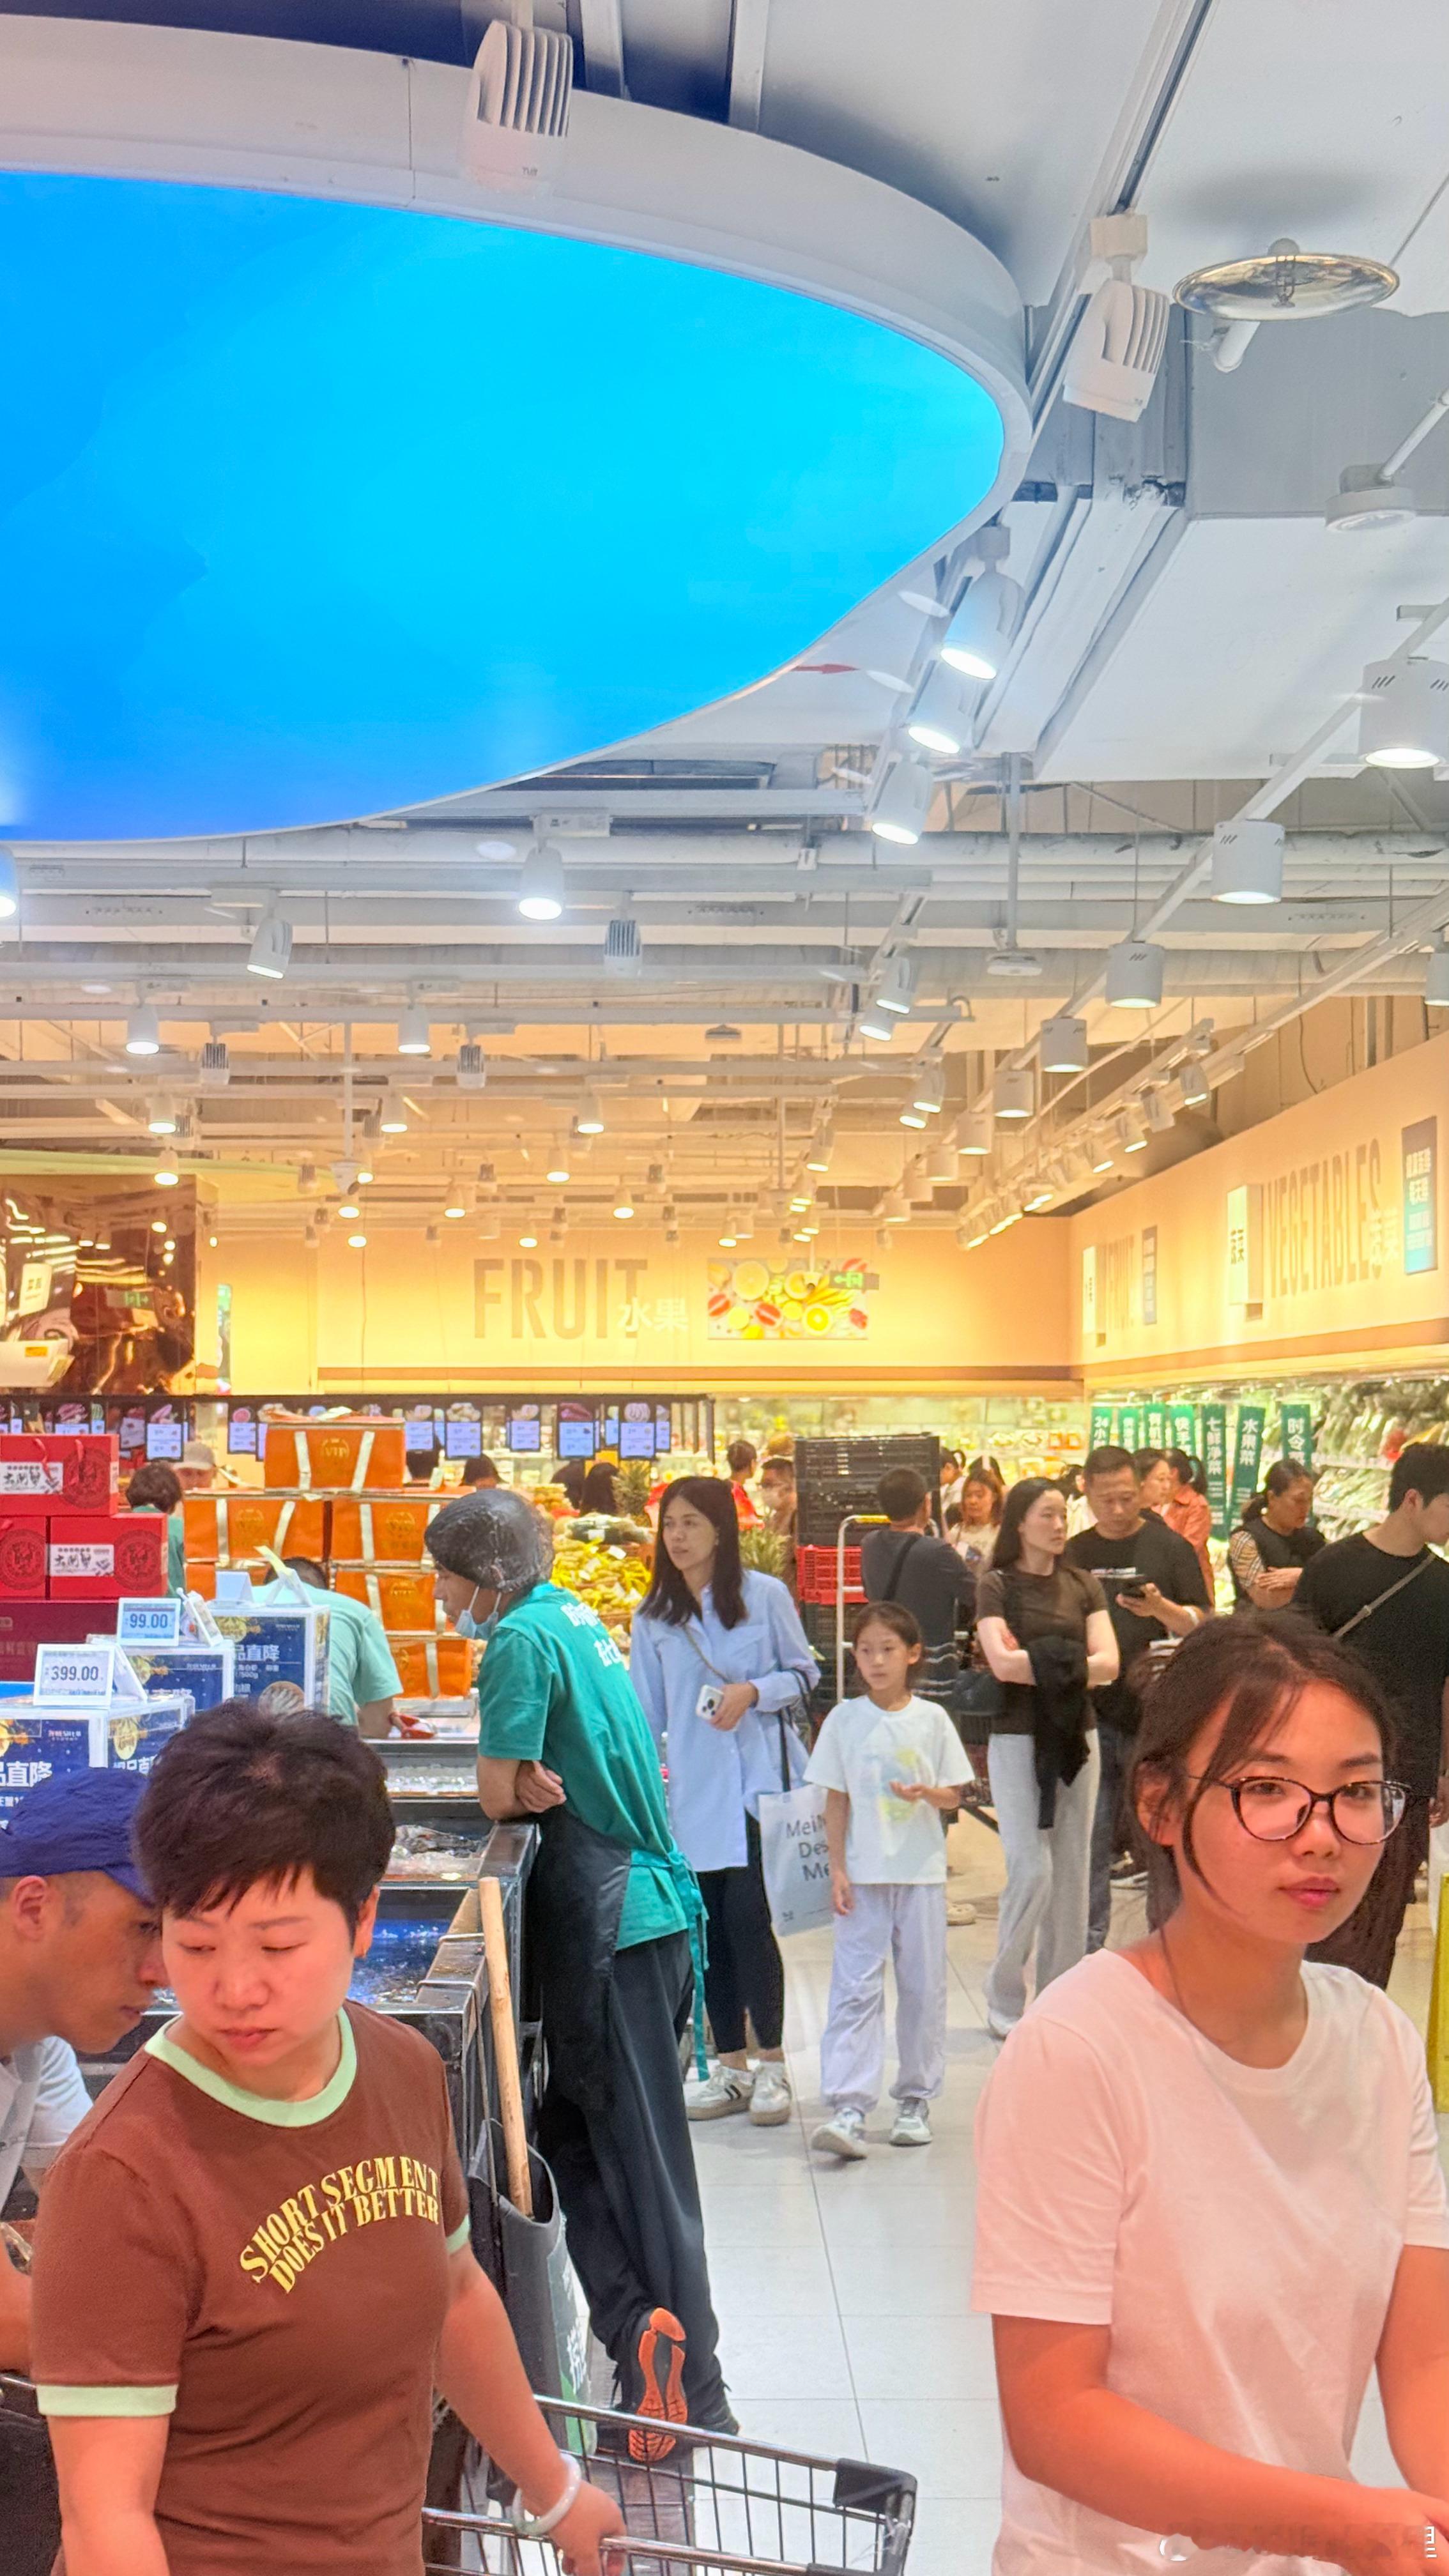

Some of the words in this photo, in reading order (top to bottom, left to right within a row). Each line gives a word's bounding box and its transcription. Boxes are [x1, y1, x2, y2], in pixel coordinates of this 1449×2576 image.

[474, 1259, 647, 1338] FRUIT
[618, 1298, 688, 1333] 水果
[130, 1614, 168, 1629] 99.00
[51, 1666, 99, 1681] 399.00
[240, 2184, 319, 2283] SHORT
[321, 2156, 440, 2206] SEGMENT
[268, 2221, 325, 2294] DOES
[321, 2202, 348, 2241] IT
[352, 2188, 440, 2227] BETTER
